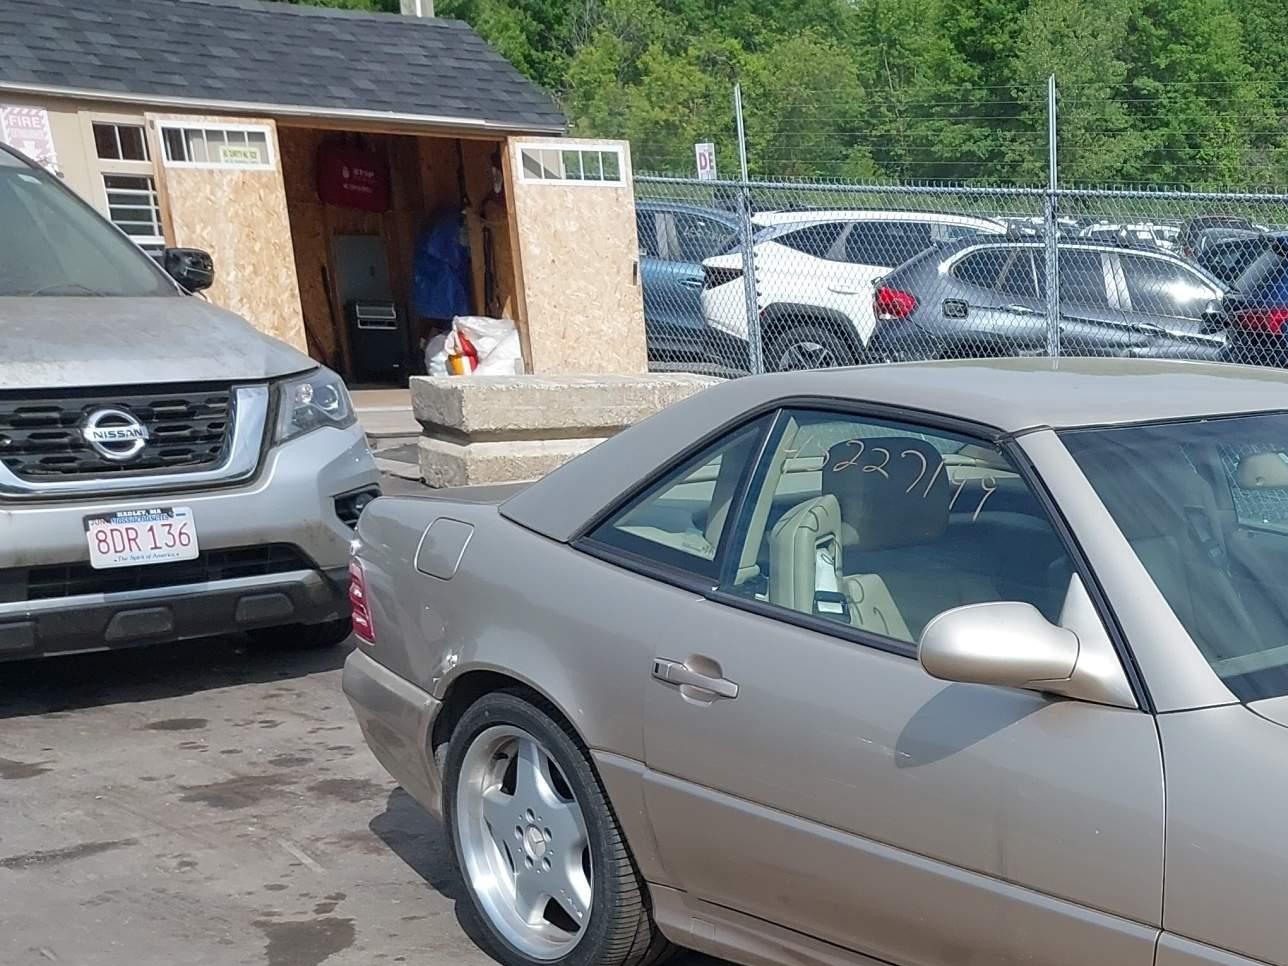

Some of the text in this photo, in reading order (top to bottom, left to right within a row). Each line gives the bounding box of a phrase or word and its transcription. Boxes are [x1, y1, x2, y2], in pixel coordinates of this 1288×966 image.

[8, 115, 41, 128] FIRE
[92, 429, 144, 440] NISSAN
[95, 521, 191, 555] 8DR 136
